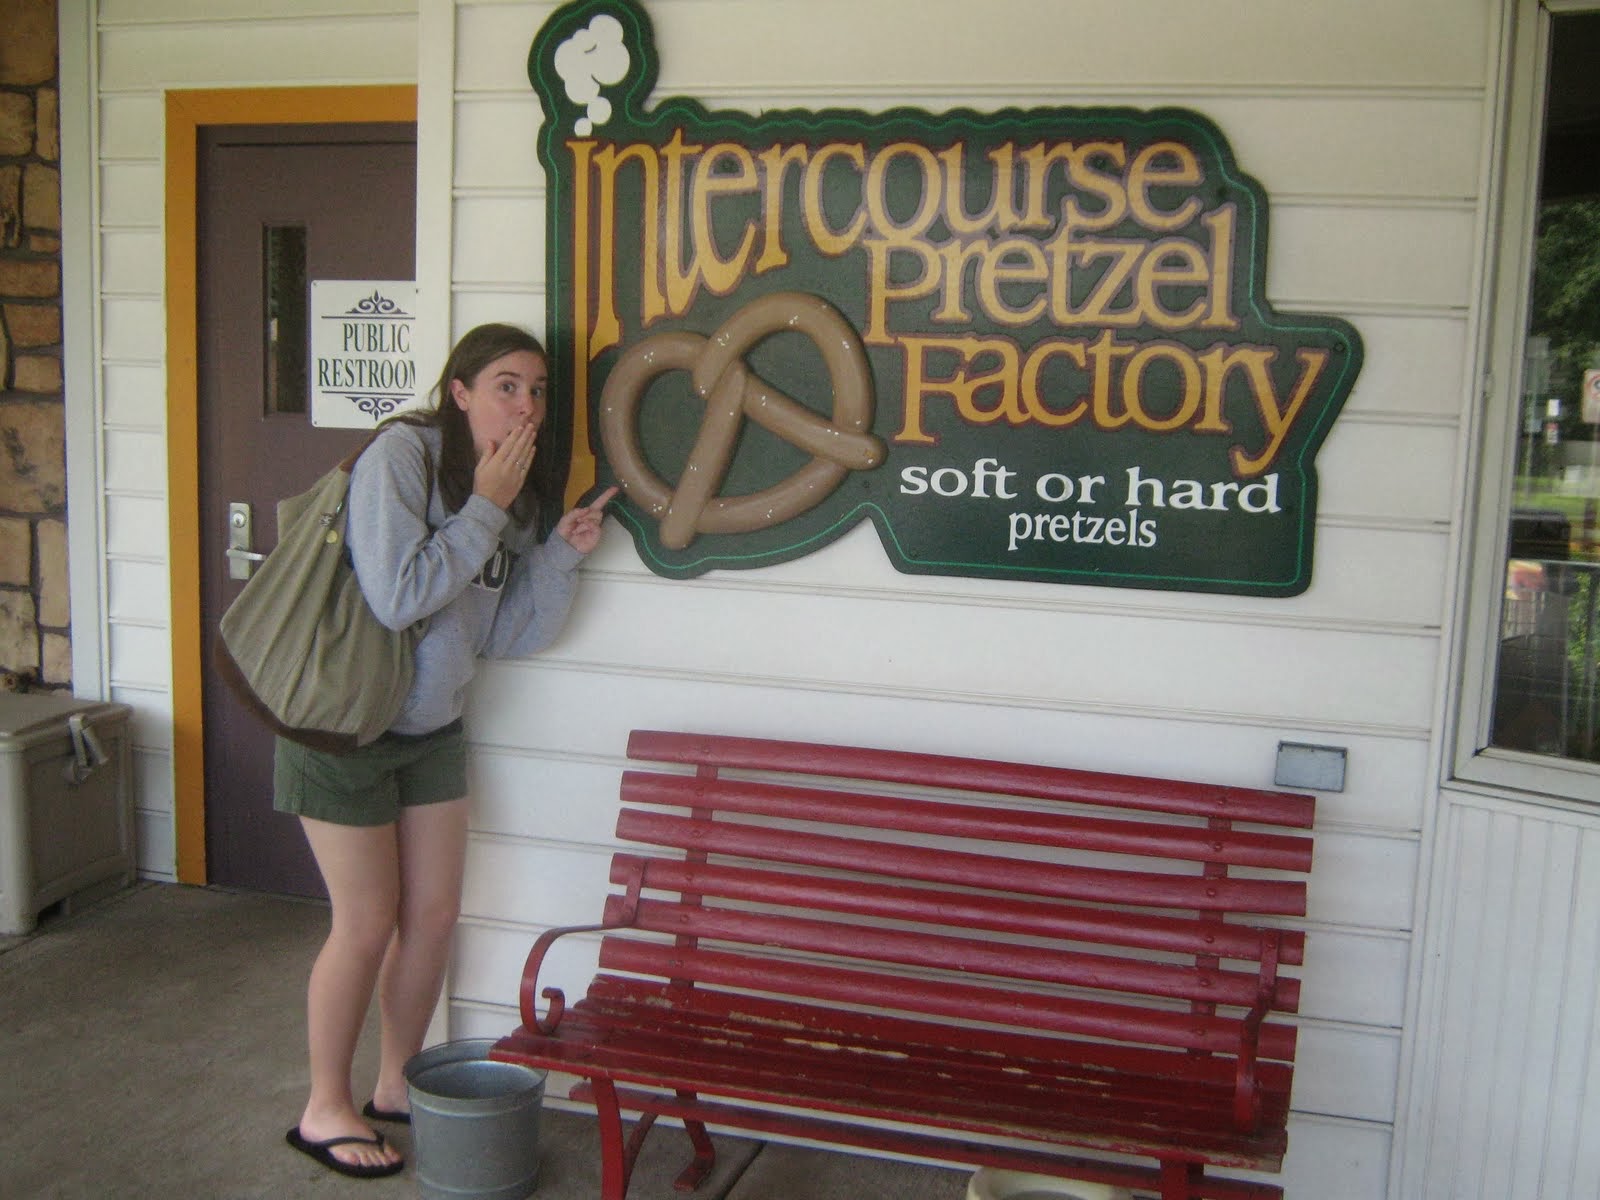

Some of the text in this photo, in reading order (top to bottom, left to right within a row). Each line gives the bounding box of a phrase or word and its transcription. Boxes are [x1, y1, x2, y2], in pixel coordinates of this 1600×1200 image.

[565, 127, 1203, 514] Intercourse
[862, 202, 1238, 344] Pretzel
[343, 323, 410, 353] PUBLIC
[893, 328, 1328, 476] Factory
[900, 458, 1282, 513] soft or hard
[1007, 510, 1157, 551] pretzels
